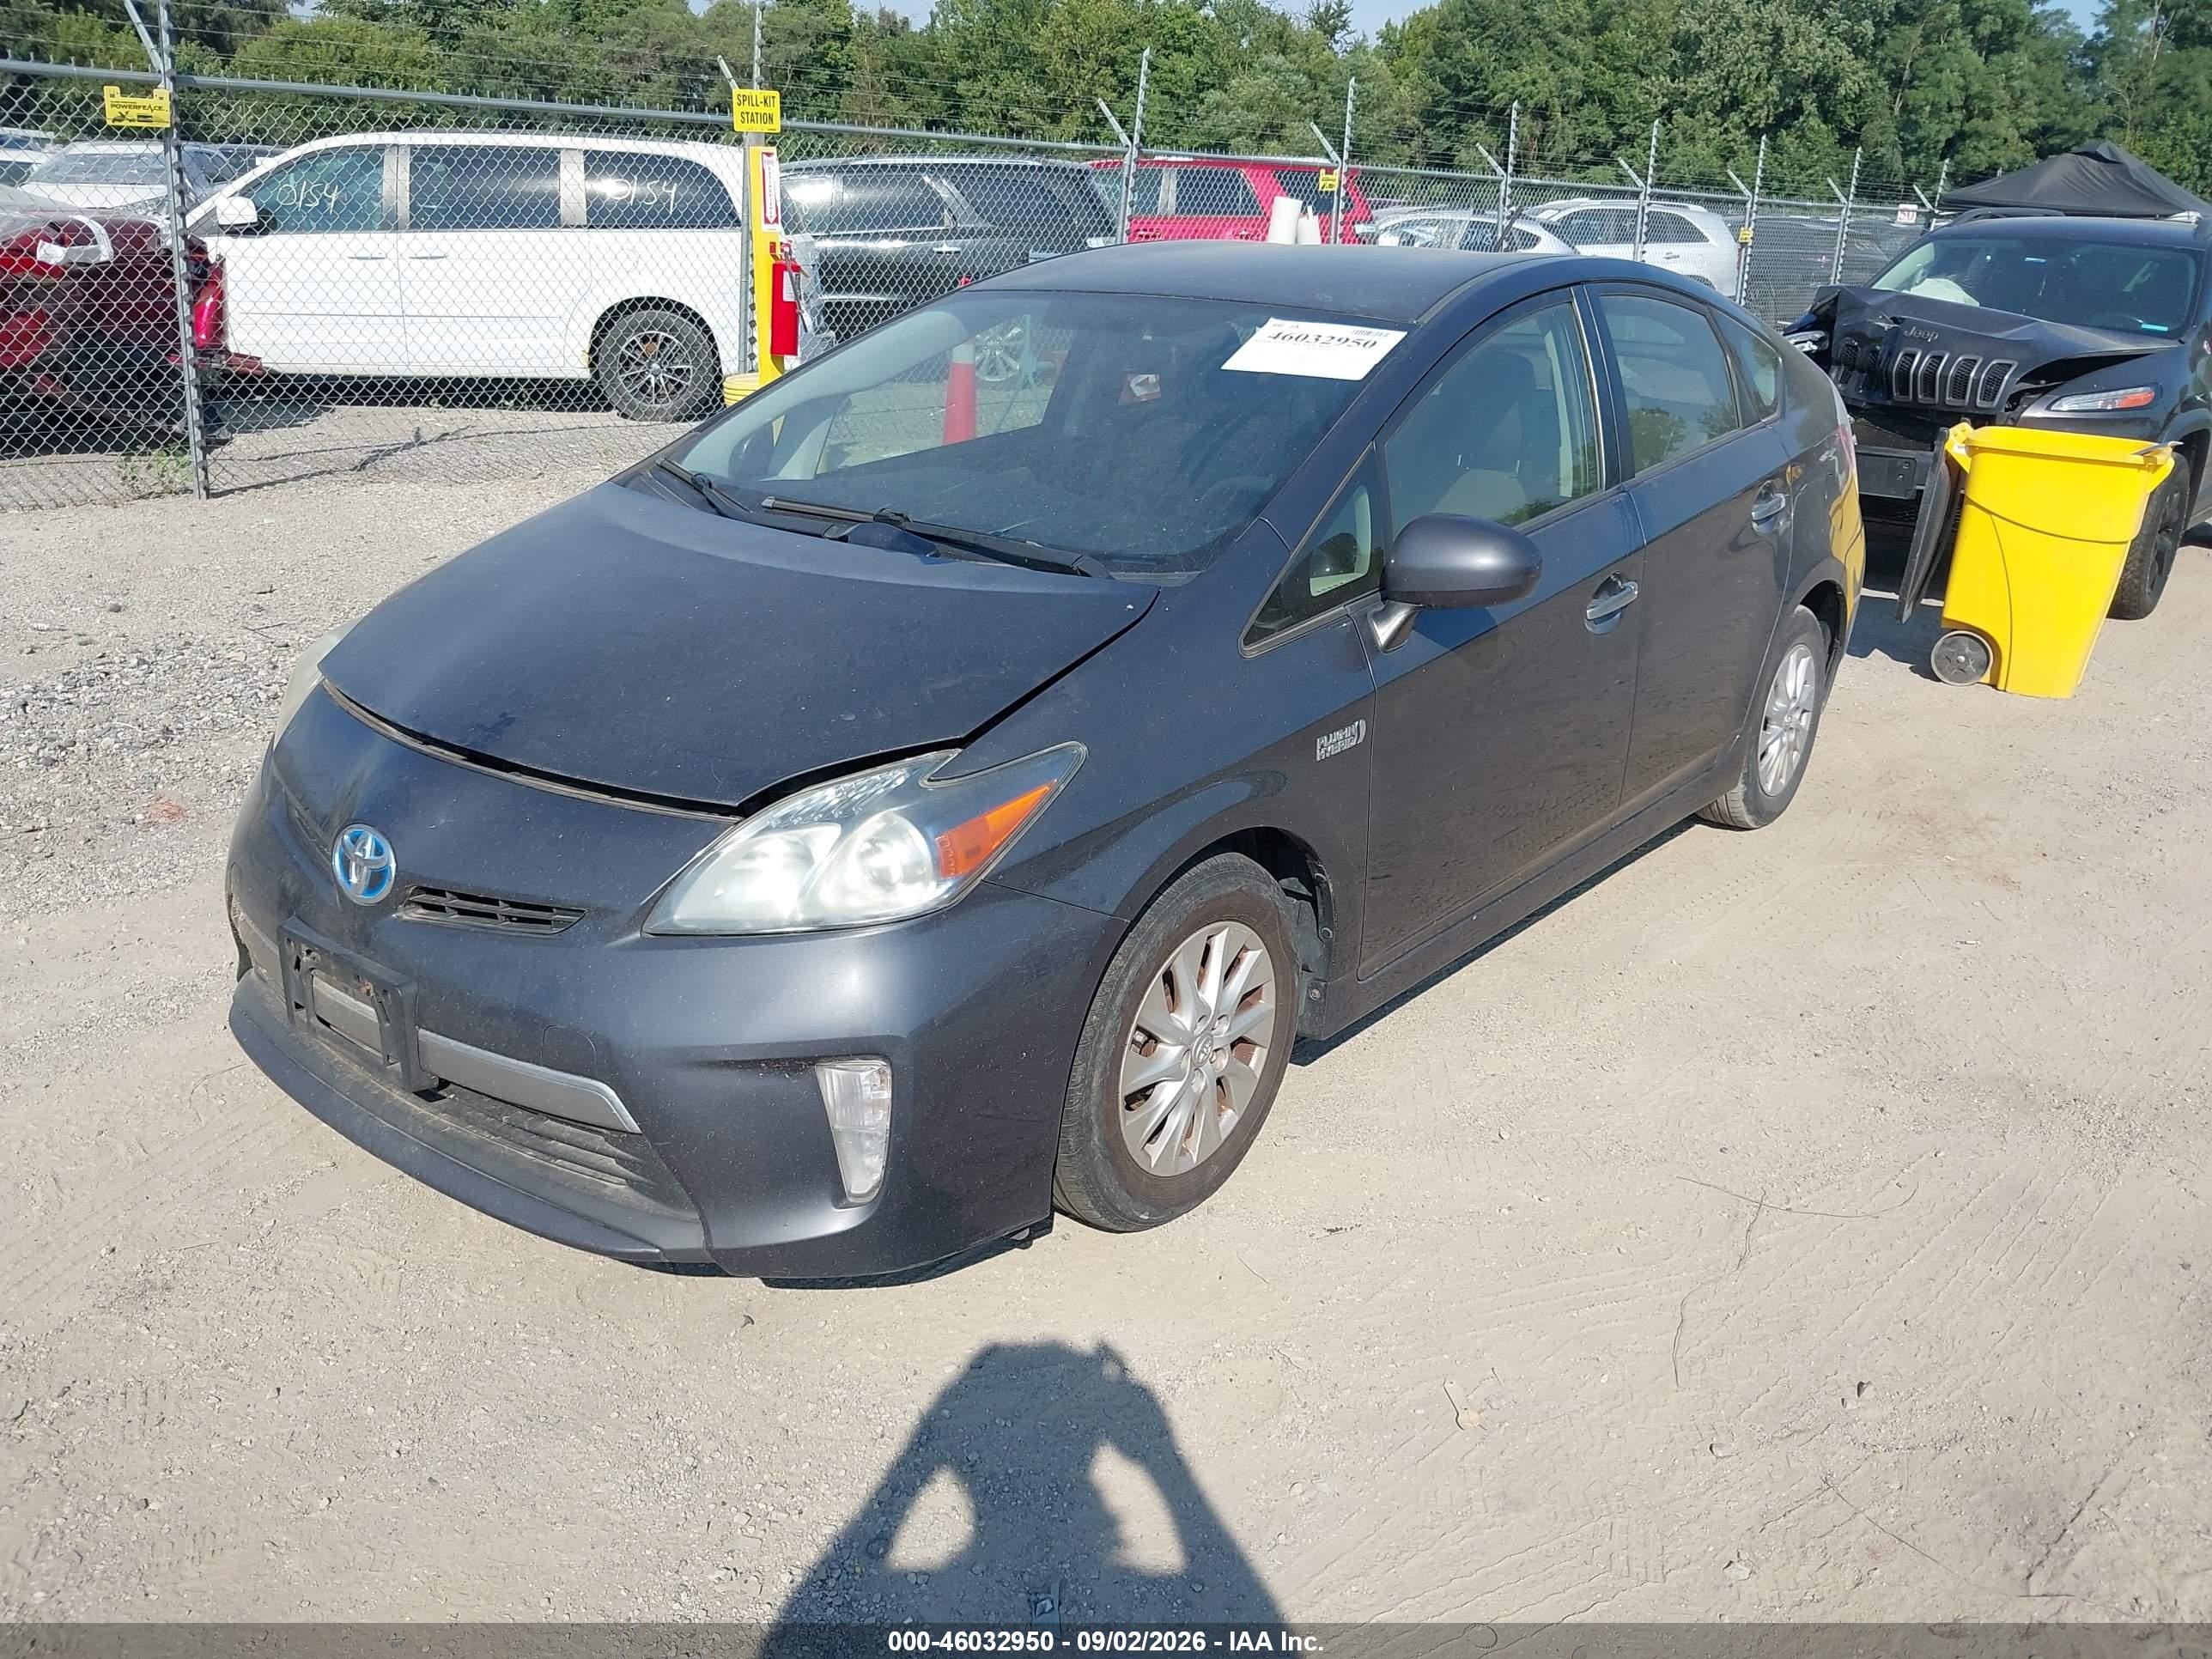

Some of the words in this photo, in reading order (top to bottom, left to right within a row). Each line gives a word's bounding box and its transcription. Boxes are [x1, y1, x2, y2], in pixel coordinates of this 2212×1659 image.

[737, 94, 776, 108] SPILL-KIT
[740, 111, 774, 125] STATION
[276, 180, 338, 216] 0154
[1267, 331, 1378, 349] 46032950
[1903, 325, 1939, 343] Jeep
